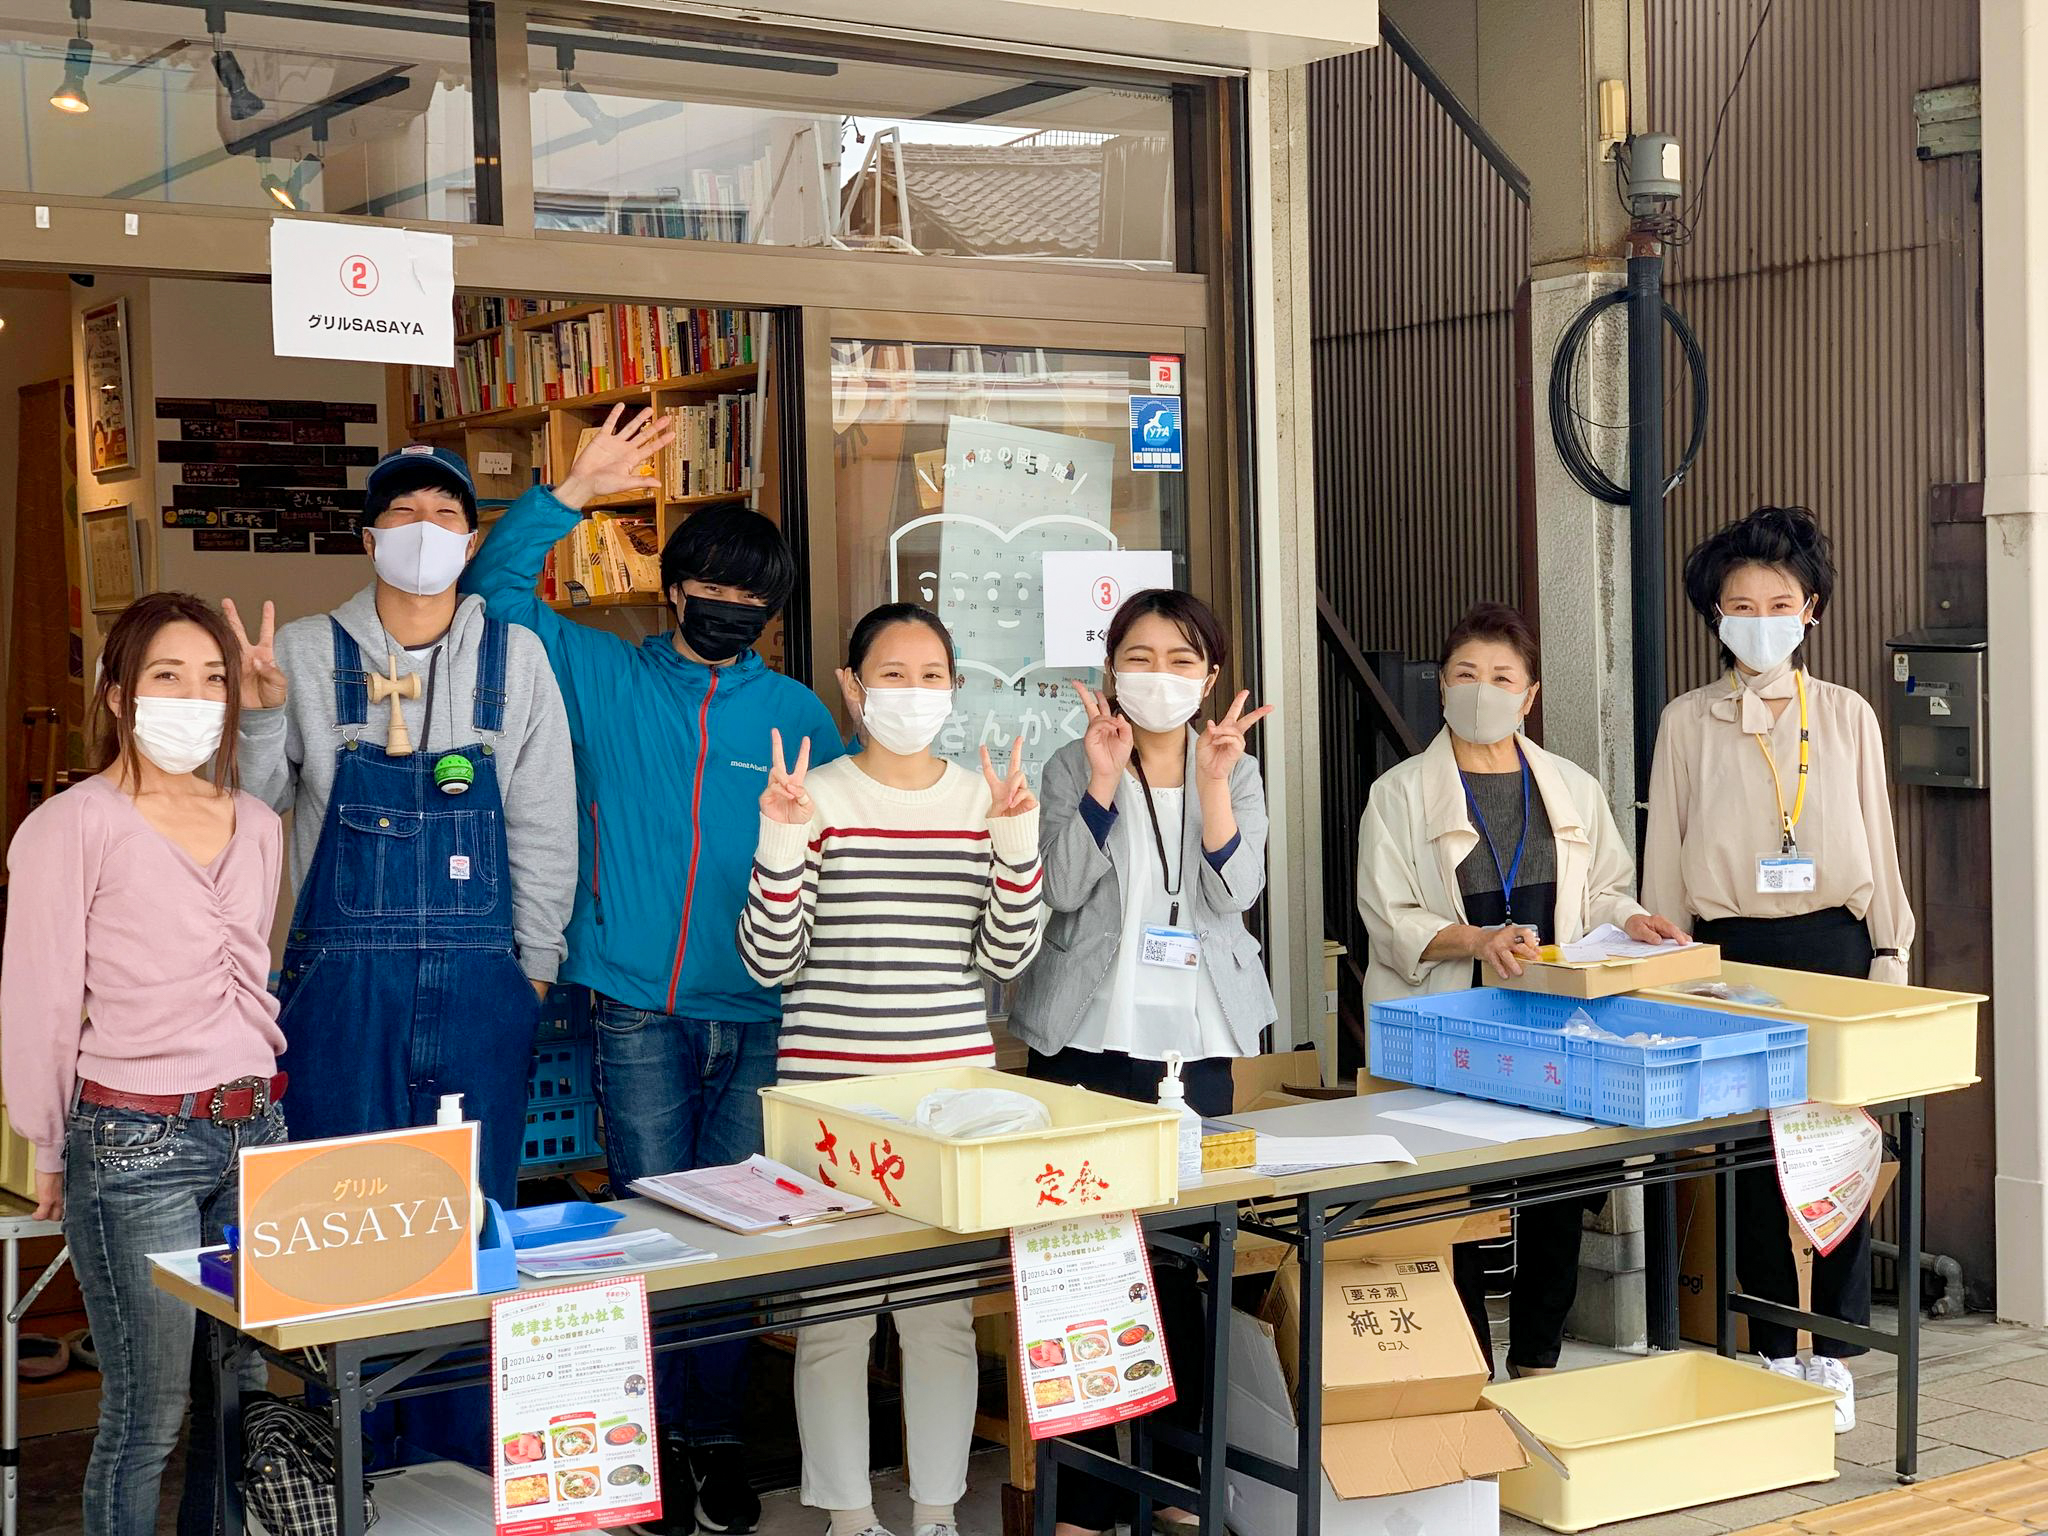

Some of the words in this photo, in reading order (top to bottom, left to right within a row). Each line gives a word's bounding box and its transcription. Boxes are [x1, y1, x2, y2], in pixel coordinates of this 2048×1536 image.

[308, 314, 424, 335] グリルSASAYA
[940, 707, 1083, 750] さんかく
[332, 1177, 389, 1201] グリル
[253, 1196, 463, 1258] SASAYA
[1026, 1226, 1122, 1253] 焼津まちなか社食
[1417, 1262, 1439, 1272] 152
[1349, 1287, 1400, 1301] 要冷凍
[511, 1305, 625, 1337] 焼津まちなか社食
[1347, 1307, 1423, 1337] 純氷
[1377, 1340, 1410, 1352] 6コ入
[509, 1353, 545, 1367] 2021.04.26
[510, 1372, 546, 1385] 2021.04.27
